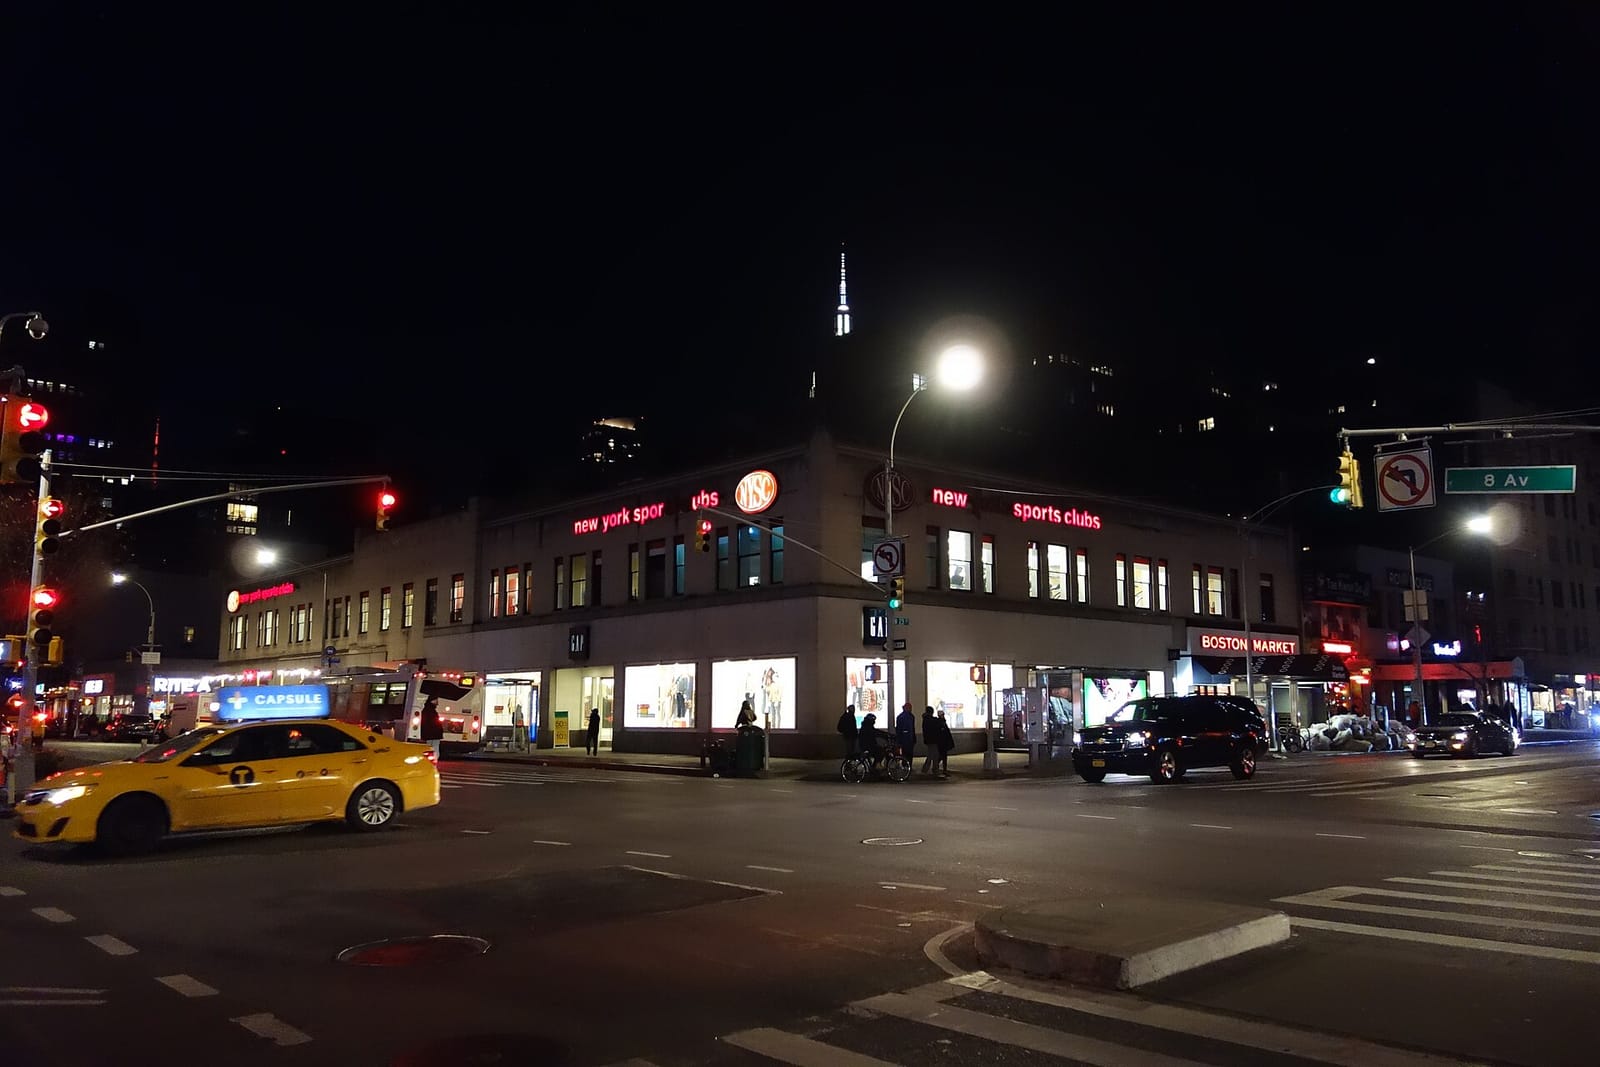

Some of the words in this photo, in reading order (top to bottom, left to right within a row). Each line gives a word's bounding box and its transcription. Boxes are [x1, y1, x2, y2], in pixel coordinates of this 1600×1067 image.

[739, 473, 773, 509] NYSC
[876, 475, 911, 507] NSC
[1483, 474, 1495, 487] 8
[1504, 473, 1528, 487] Av
[932, 488, 968, 508] new
[574, 518, 598, 535] new
[602, 507, 630, 533] york
[1013, 502, 1061, 523] sports
[1064, 508, 1101, 529] clubs
[1201, 635, 1248, 651] BOSTON
[1253, 639, 1295, 654] MARKET
[254, 693, 322, 705] CAPSULE
